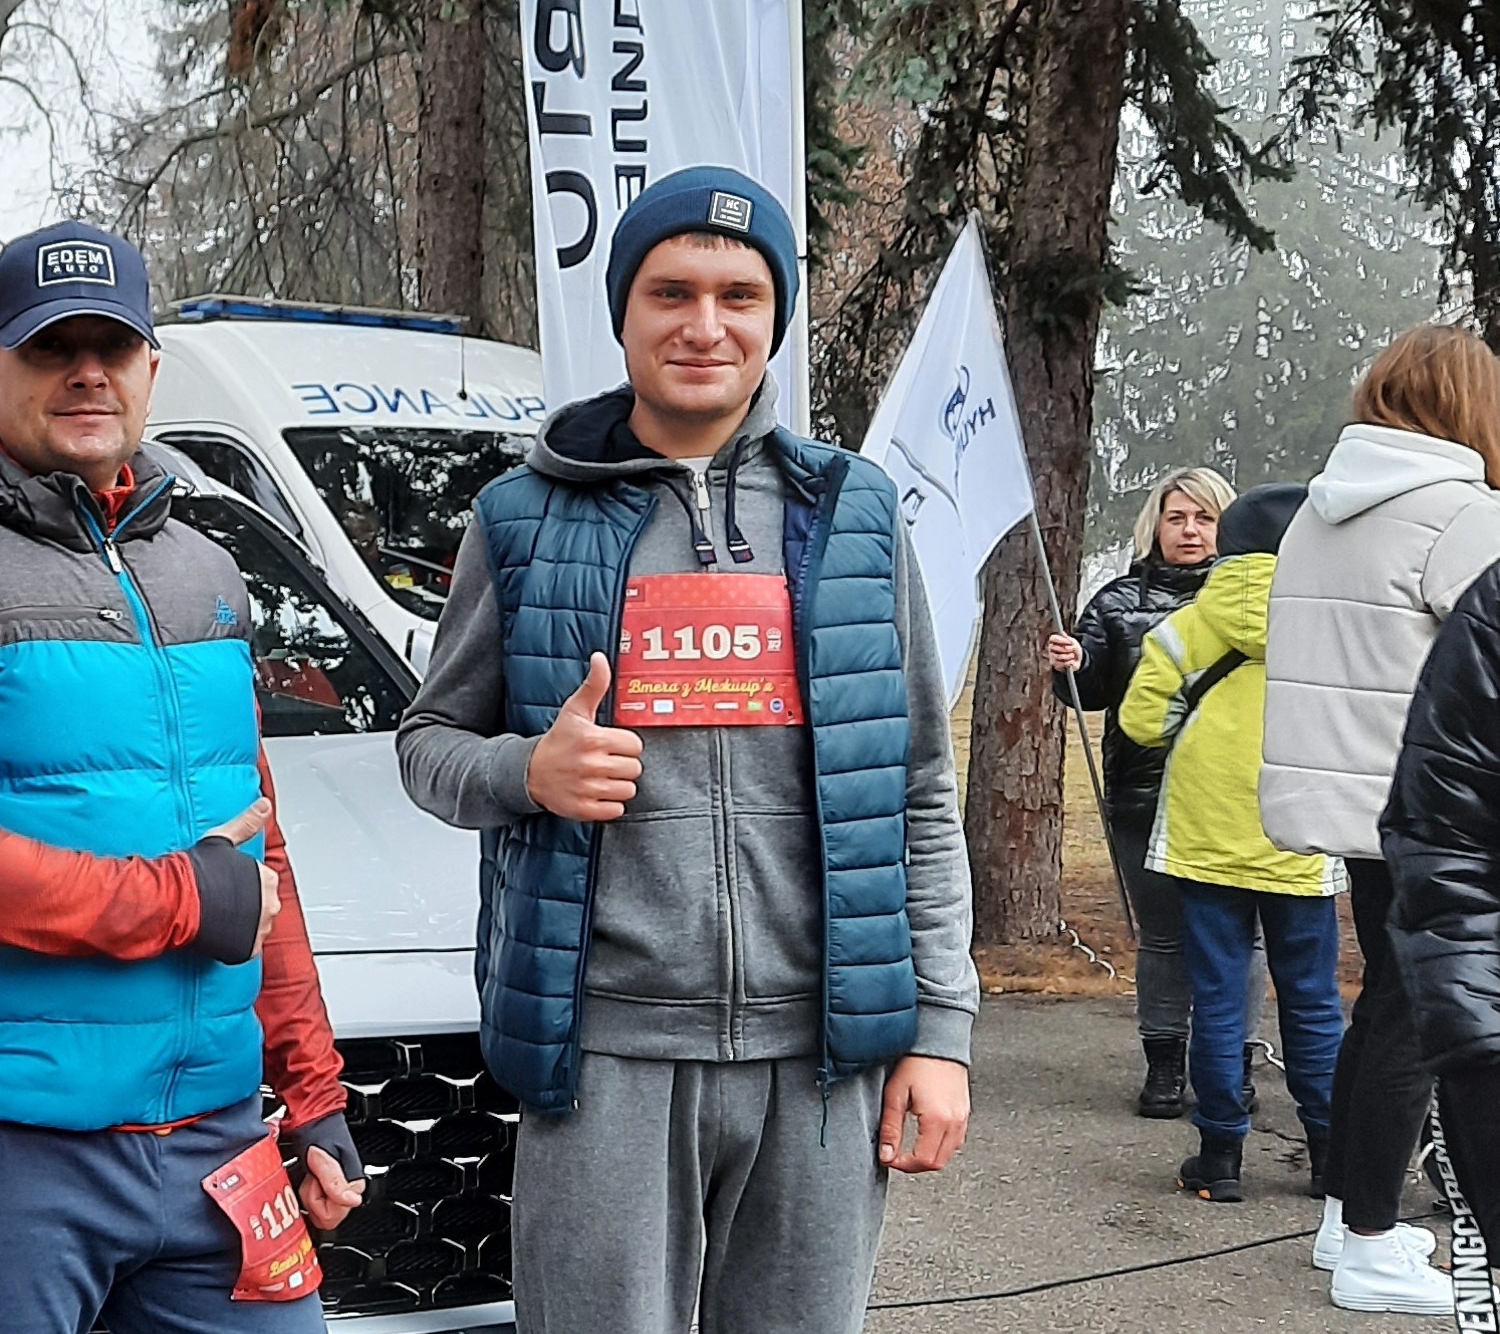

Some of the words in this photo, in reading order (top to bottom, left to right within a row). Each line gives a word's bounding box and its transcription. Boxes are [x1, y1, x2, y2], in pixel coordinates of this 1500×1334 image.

[47, 250, 104, 266] EDEM
[53, 265, 99, 274] AUTO
[642, 624, 762, 660] 1105
[261, 1184, 300, 1239] 110
